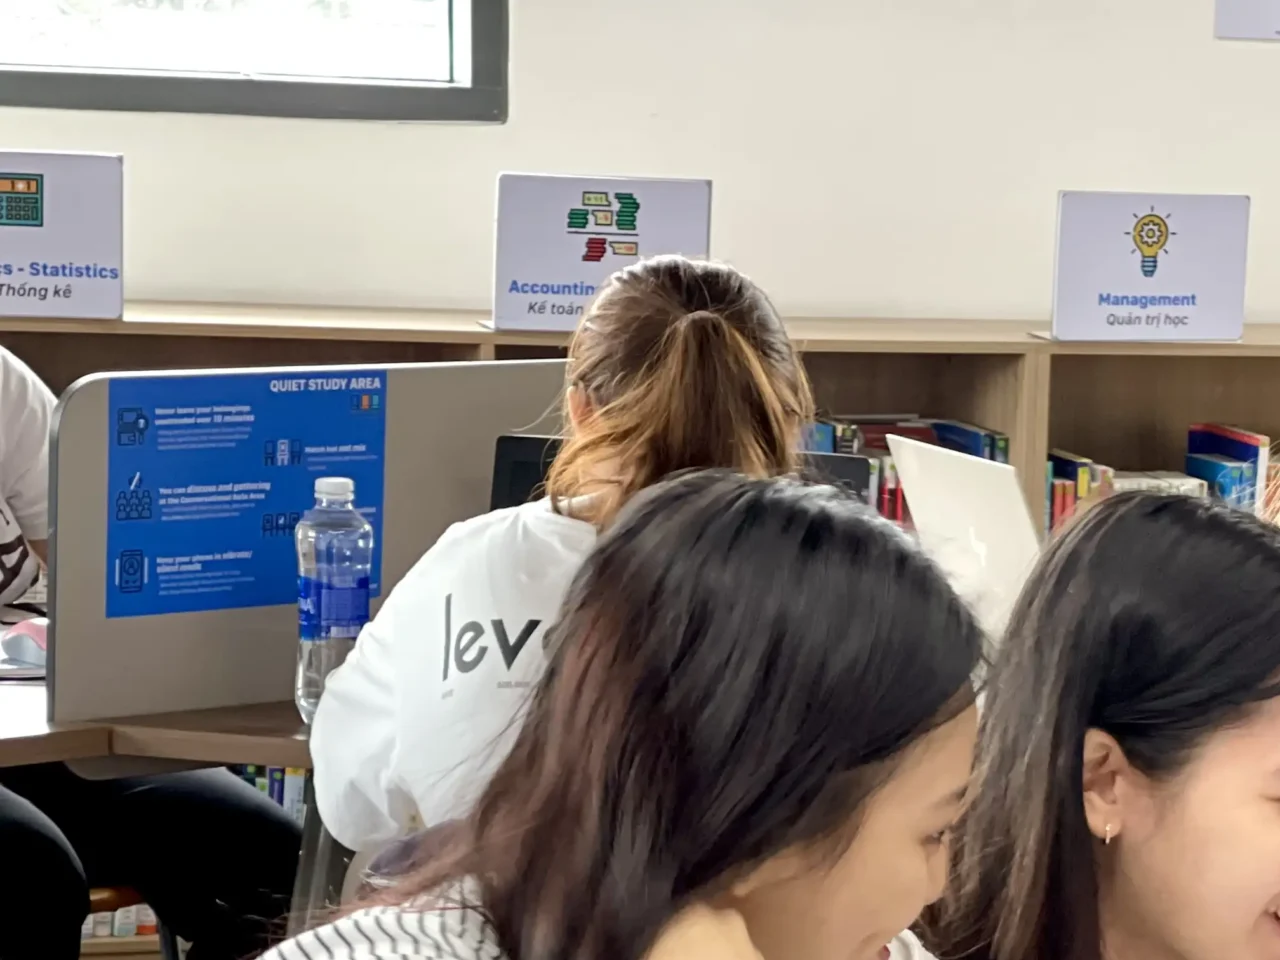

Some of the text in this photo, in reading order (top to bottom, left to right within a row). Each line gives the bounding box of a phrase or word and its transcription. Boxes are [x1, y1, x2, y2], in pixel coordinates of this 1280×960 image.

[29, 262, 118, 279] Statistics
[0, 281, 72, 300] Thống kê
[509, 280, 596, 296] Accountin
[528, 300, 584, 315] Kế toán
[1098, 293, 1197, 309] Management
[1107, 311, 1189, 328] Quản trị học
[270, 377, 381, 392] QUIET STUDY AREA
[442, 593, 542, 681] lev
